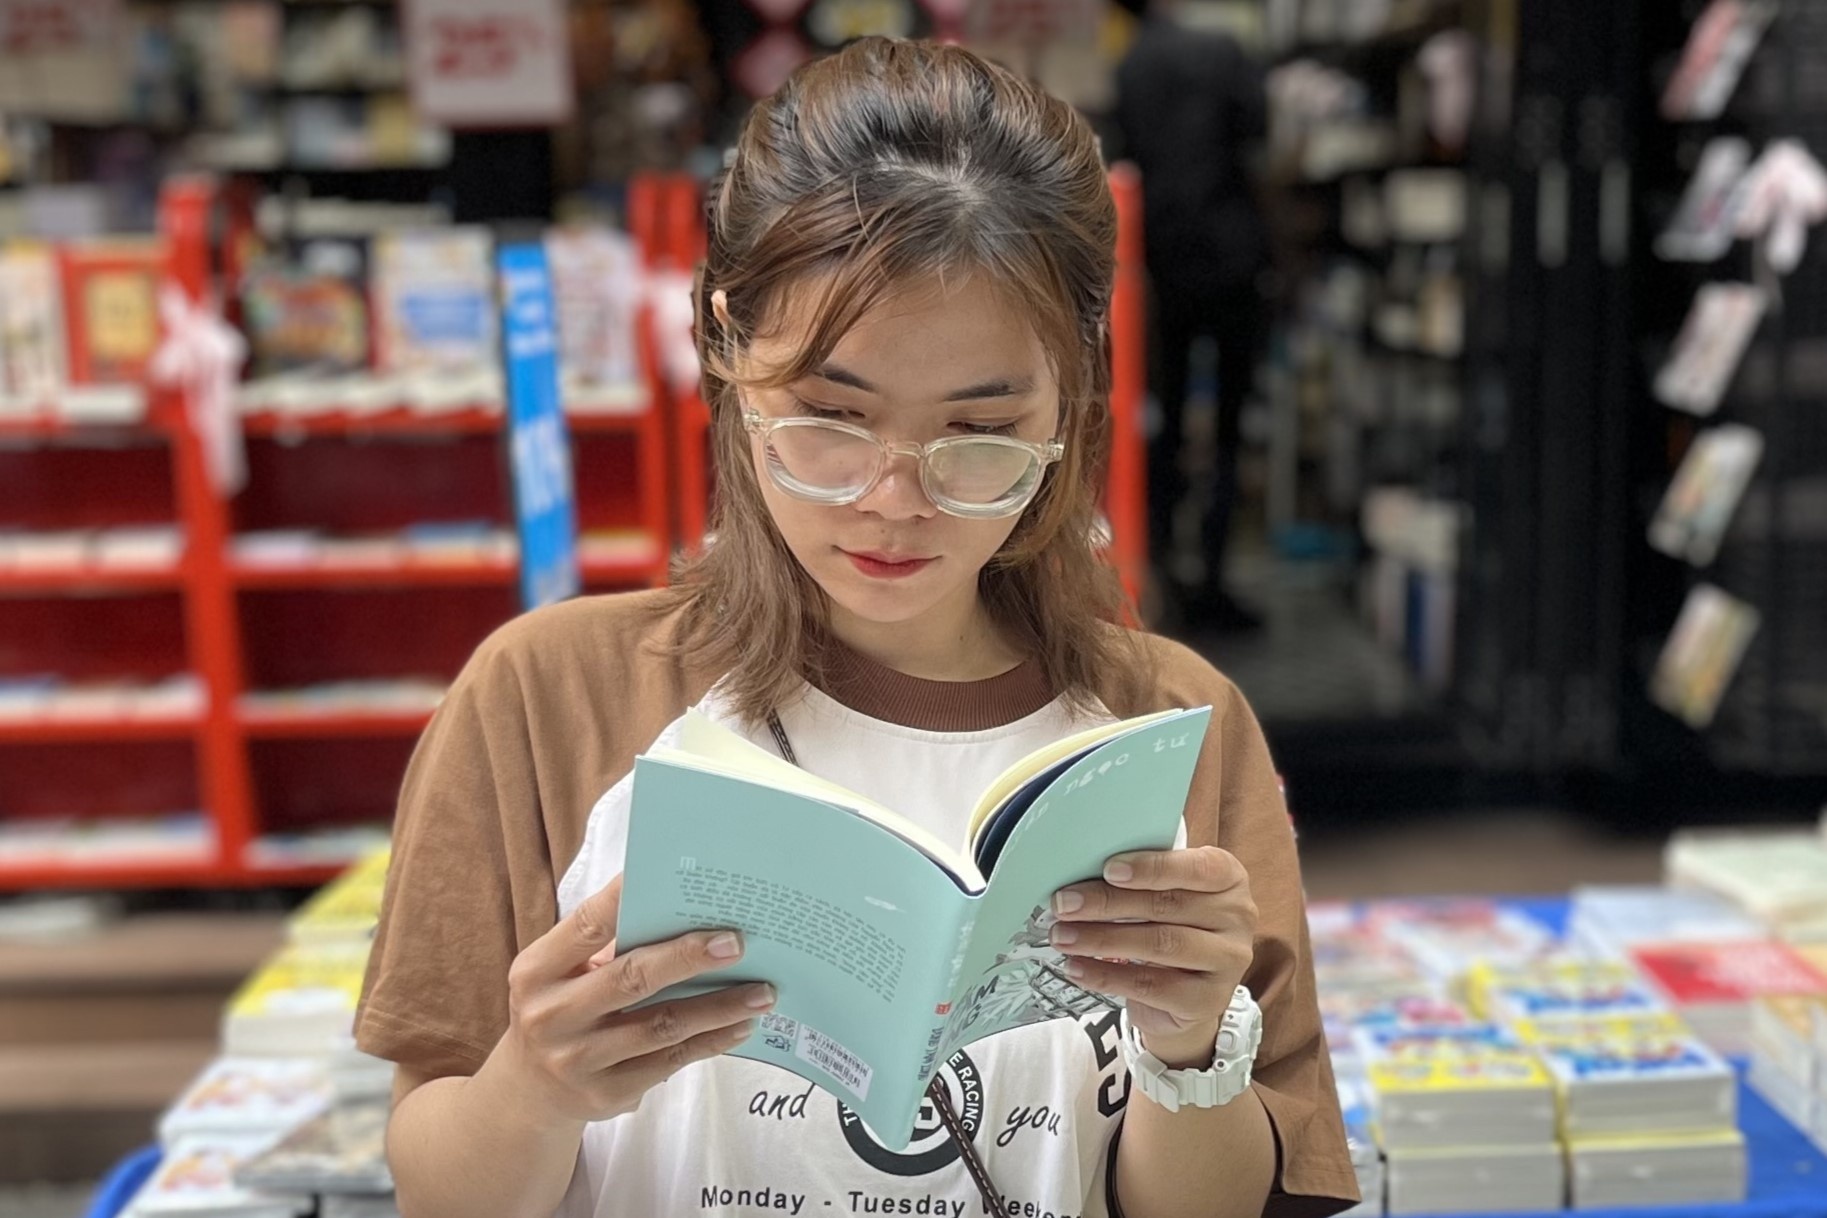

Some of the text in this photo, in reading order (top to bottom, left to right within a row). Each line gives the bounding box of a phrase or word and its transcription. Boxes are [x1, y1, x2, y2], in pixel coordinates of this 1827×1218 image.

[748, 1082, 815, 1120] and
[958, 1065, 980, 1133] RACING
[996, 1105, 1061, 1148] you
[701, 1186, 805, 1216] Monday
[848, 1191, 966, 1217] Tuesday
